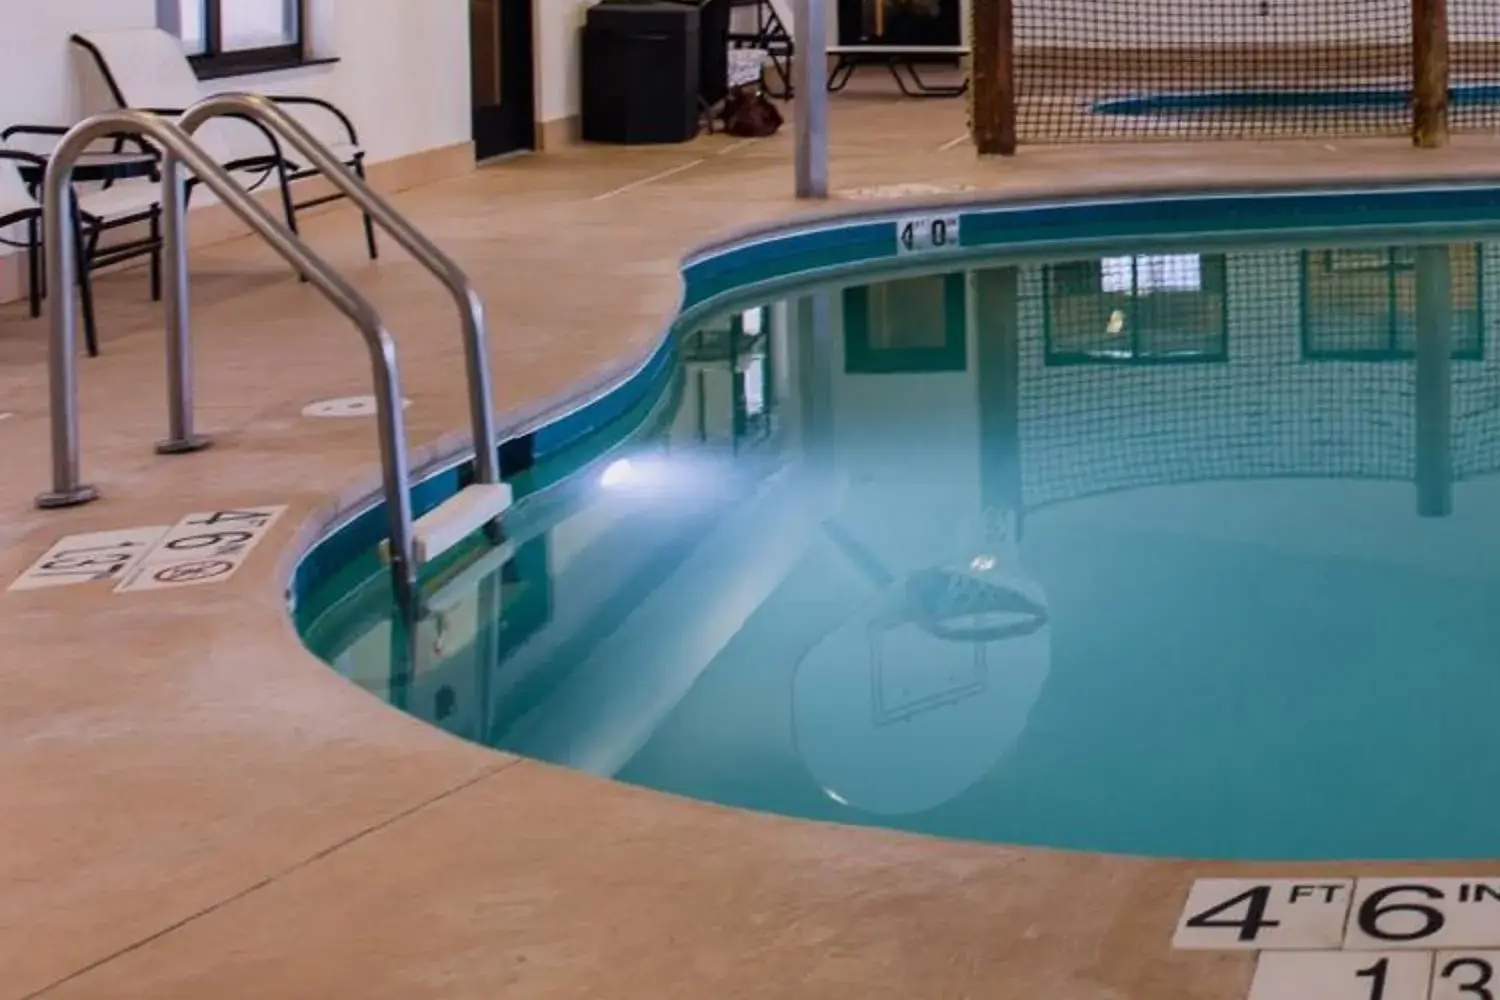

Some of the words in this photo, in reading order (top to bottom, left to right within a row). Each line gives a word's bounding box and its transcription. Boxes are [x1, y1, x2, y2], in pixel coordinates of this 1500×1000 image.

[1186, 885, 1280, 941] 4
[1288, 884, 1345, 903] FT
[1358, 885, 1445, 941] 6
